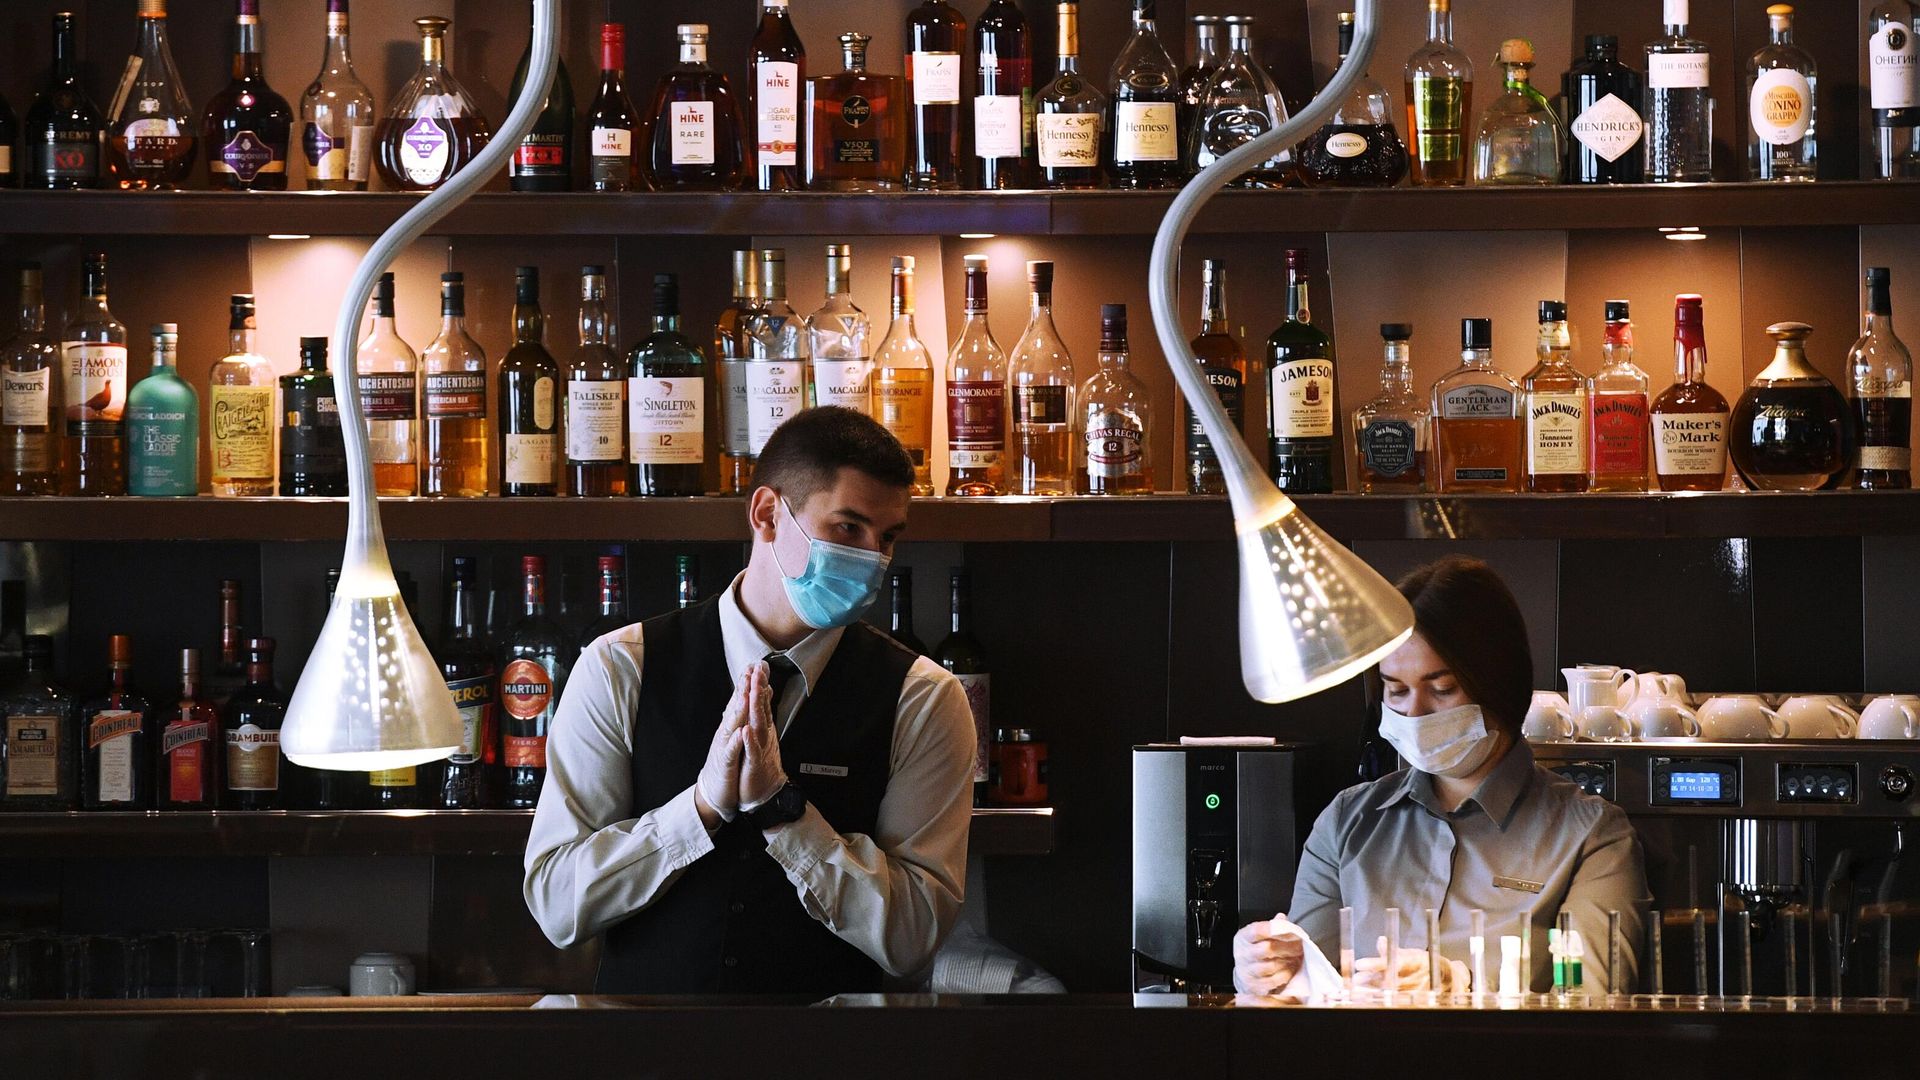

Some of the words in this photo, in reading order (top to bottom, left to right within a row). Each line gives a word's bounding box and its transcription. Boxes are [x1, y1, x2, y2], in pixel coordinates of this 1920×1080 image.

[766, 79, 790, 87] HINE
[1767, 100, 1801, 110] ONINO
[680, 114, 705, 123] HINE
[1767, 112, 1797, 120] GRAPPA
[1126, 122, 1169, 133] Hennessy
[1047, 130, 1090, 145] Hennessy
[417, 143, 432, 151] XO
[1331, 139, 1361, 149] Hennessy
[80, 358, 124, 367] FAMOUS
[79, 368, 123, 377] GROUSE
[5, 379, 45, 392] Dewar's
[358, 378, 415, 389] AUCHENTOSHAN
[427, 377, 485, 388] AUCHENTOSHAN
[1206, 375, 1237, 388] ESON
[753, 385, 800, 394] MACALLAN
[872, 388, 922, 396] LENMORANGIE
[948, 388, 1001, 397] GLENMORANGIE
[573, 392, 620, 401] TALISKER
[644, 397, 695, 411] SINGLETON
[770, 406, 784, 417] 12
[1532, 404, 1551, 420] JACK
[1551, 401, 1581, 419] DANIEL'S
[1662, 420, 1721, 430] Maker's
[660, 434, 672, 446] 12
[1086, 429, 1113, 441] CHIVAS
[1114, 429, 1140, 441] REGAL
[1540, 433, 1573, 441] Tennessee
[1679, 432, 1720, 443] Mark
[1108, 442, 1117, 451] 12
[970, 454, 979, 462] 12
[451, 684, 488, 704] PEROL
[504, 684, 548, 694] MARTINI
[92, 717, 138, 742] COINTREAU
[165, 727, 207, 750] COINTREAU
[227, 733, 279, 743] DRAMBUIE
[1200, 763, 1226, 771] marco
